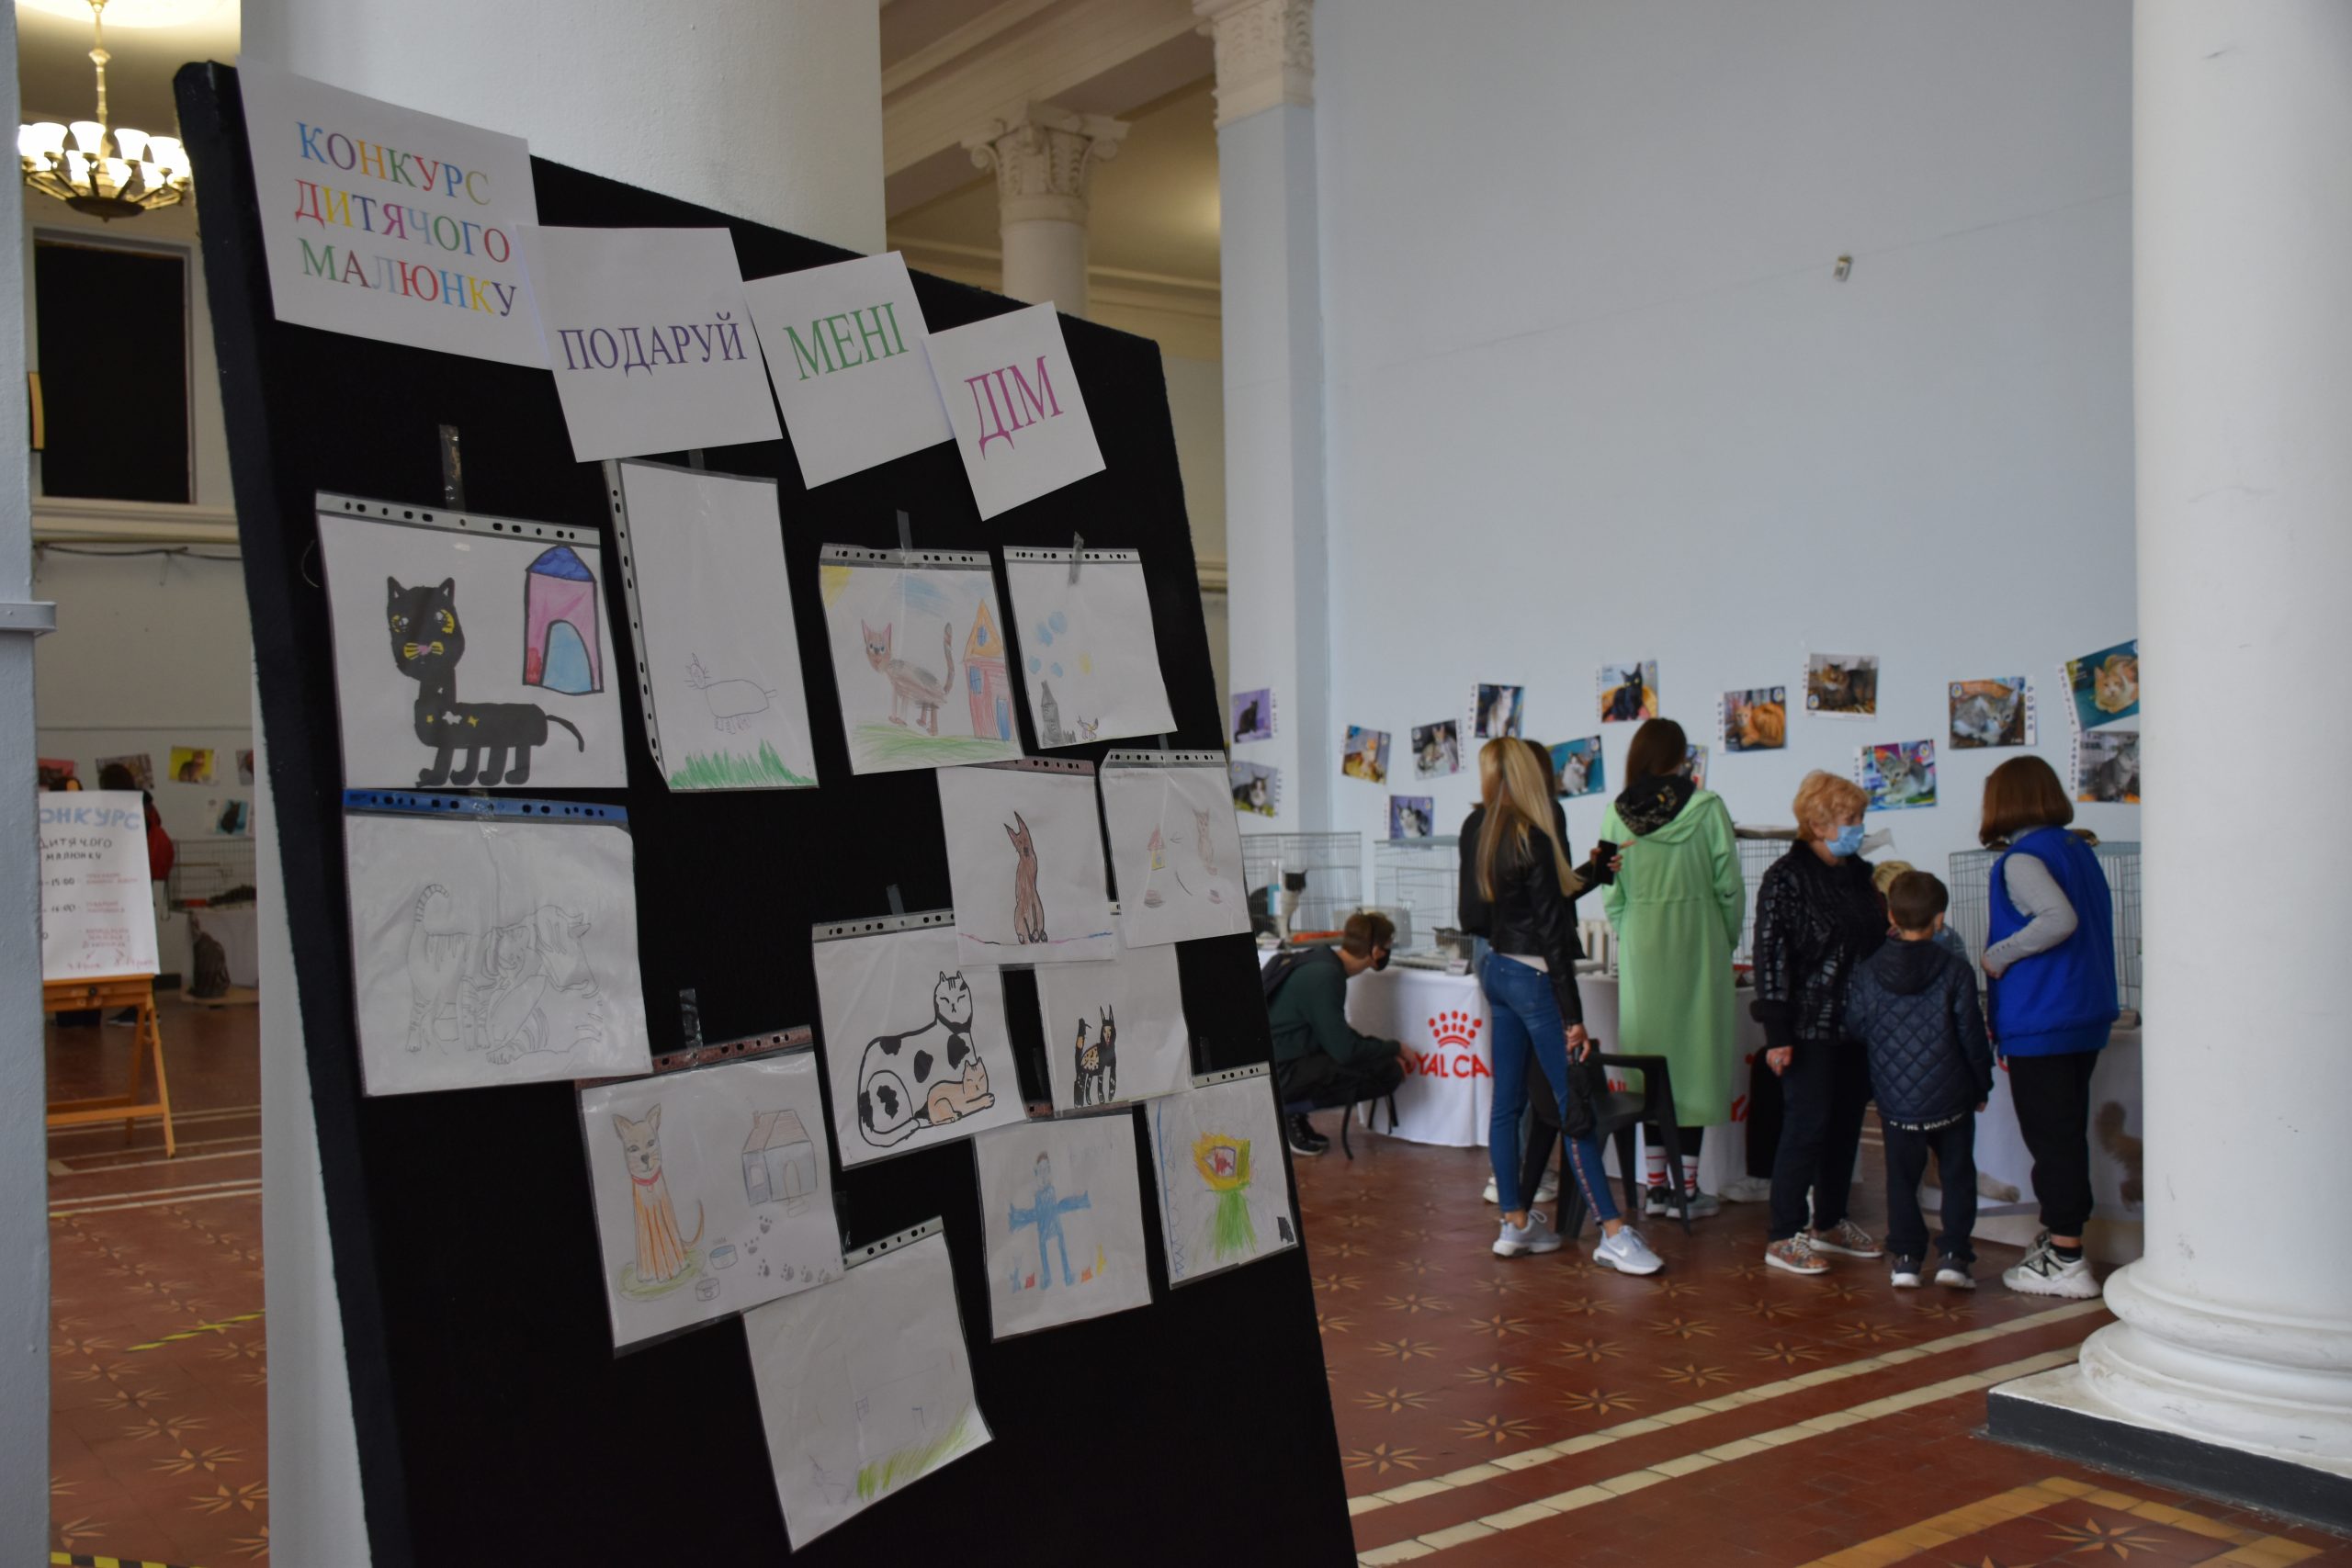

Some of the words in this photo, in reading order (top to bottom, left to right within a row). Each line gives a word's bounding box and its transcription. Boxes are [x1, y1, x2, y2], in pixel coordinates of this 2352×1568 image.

[295, 120, 492, 207] КОНКУРС
[294, 178, 511, 264] ДИТЯЧОГО
[298, 237, 517, 317] МАЛЮНКУ
[557, 311, 749, 378] ПОДАРУЙ
[782, 301, 910, 381] МЕНІ
[964, 355, 1065, 461] ДІМ
[40, 807, 141, 830] ОНКУРС
